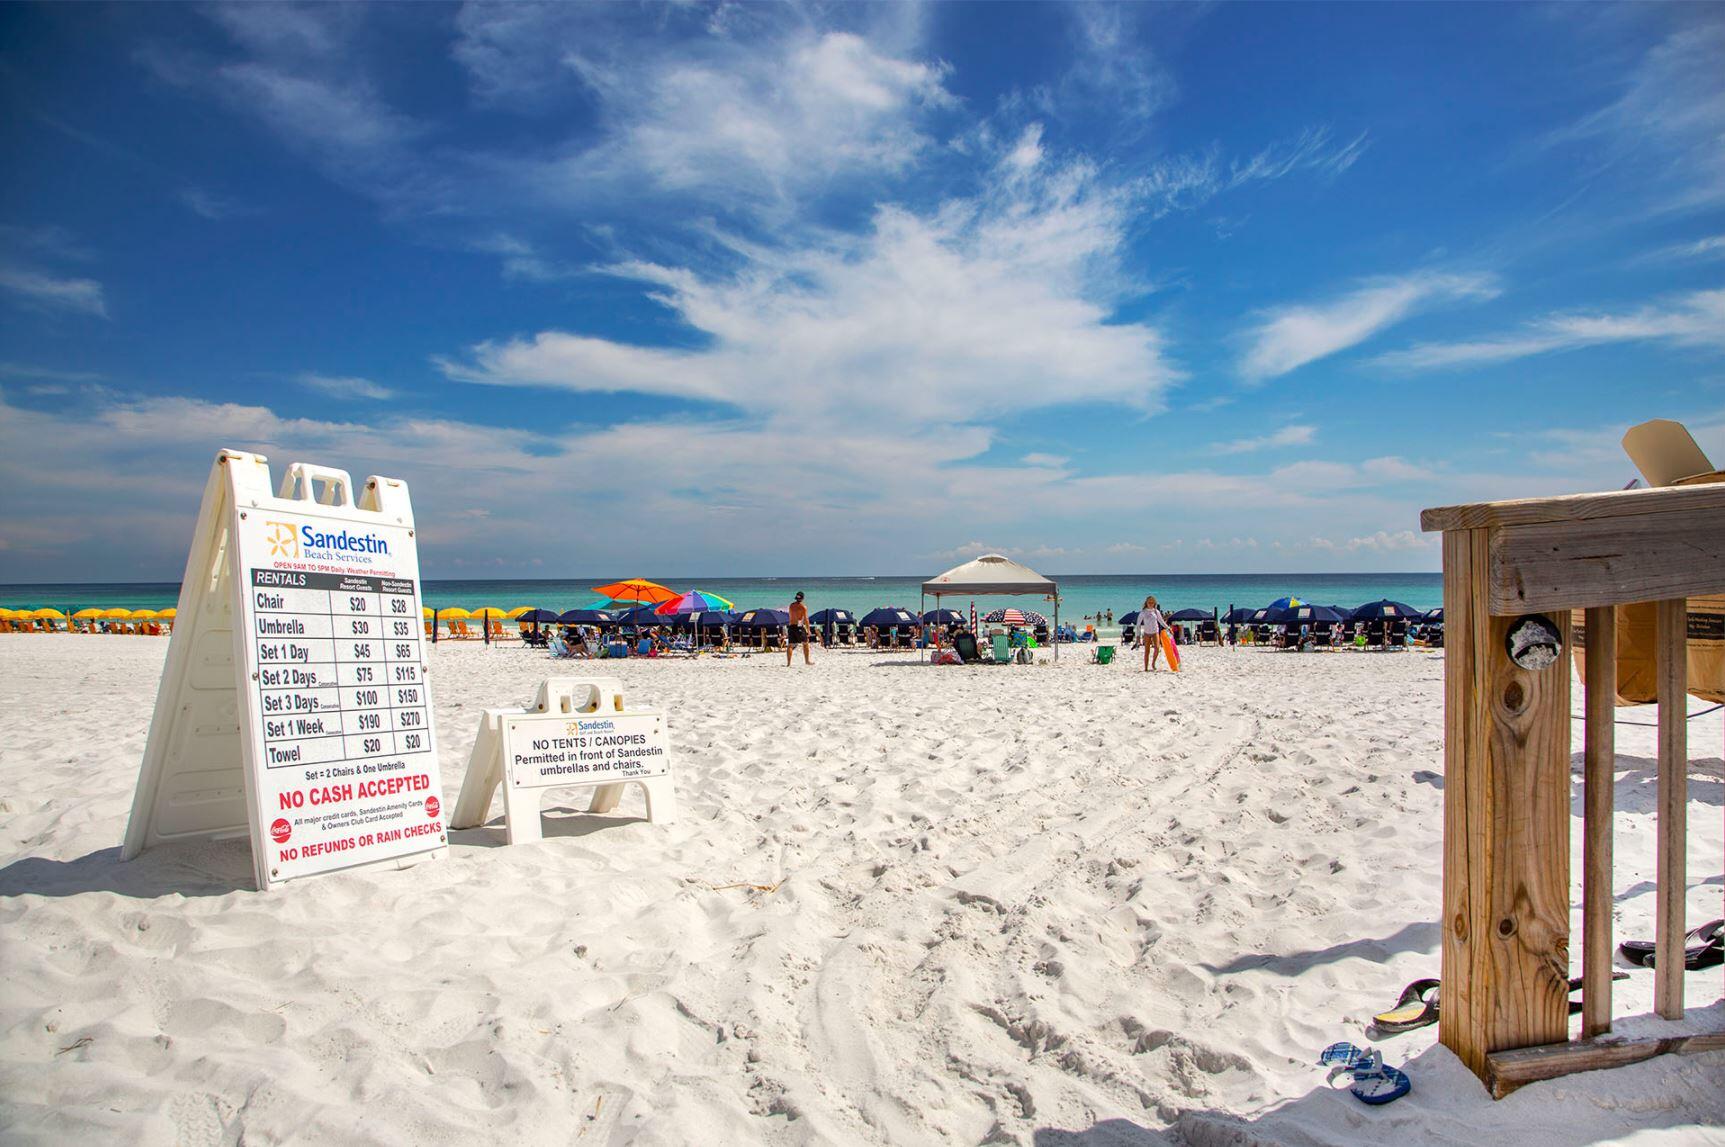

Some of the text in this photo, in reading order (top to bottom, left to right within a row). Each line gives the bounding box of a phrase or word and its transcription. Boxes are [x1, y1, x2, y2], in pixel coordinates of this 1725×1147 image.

[301, 525, 389, 555] Sandestin
[304, 549, 372, 564] Beach Services
[274, 561, 292, 570] OPEN
[293, 563, 306, 571] 9AM
[308, 564, 316, 572] TO
[317, 565, 330, 573] 5PM
[347, 567, 369, 575] Weather
[369, 569, 396, 578] Permitting
[256, 571, 306, 586] RENTALS
[344, 577, 368, 585] Sandestin
[340, 583, 356, 591] Resort
[257, 593, 285, 609] Chair
[350, 597, 366, 612] $20
[391, 599, 407, 613] $28
[259, 618, 305, 635] Umbrella
[352, 621, 369, 634] $30
[393, 621, 409, 635] $35
[261, 644, 309, 663] Set 1 Day
[354, 643, 371, 658] $45
[396, 644, 411, 658] $65
[262, 670, 281, 685] Set
[283, 669, 290, 685] 2
[292, 669, 317, 687] Days
[356, 667, 373, 682] $75
[396, 667, 416, 681] $115
[265, 696, 282, 711] Set
[285, 695, 292, 710] 3
[294, 694, 319, 713] Days
[356, 690, 378, 706] $100
[398, 689, 418, 703] $150
[267, 721, 285, 737] Set
[288, 721, 294, 736] 1
[297, 718, 325, 735] Week
[359, 714, 381, 730] $190
[400, 712, 421, 727] $270
[578, 720, 614, 731] Sandestin
[363, 738, 381, 753] $20
[406, 735, 421, 749] $20
[532, 734, 646, 750] NO TENTS / CANOPIES
[269, 745, 301, 764] Towel
[515, 746, 663, 765] Permitted in front of Sandestin
[305, 770, 318, 781] Set
[326, 769, 331, 778] 2
[333, 767, 355, 777] Chairs
[356, 766, 362, 774] &
[363, 764, 376, 773] One
[377, 761, 406, 772] Umbrella
[540, 759, 644, 776] umbrellas and chairs.
[279, 774, 430, 810] NO CASH ACCEPTED
[294, 818, 303, 826] All
[304, 815, 321, 825] major
[323, 813, 340, 822] credit
[341, 811, 359, 821] cards,
[359, 806, 386, 816] Sandestin
[387, 803, 408, 812] Amenity
[408, 800, 423, 809] Cards
[327, 821, 349, 830] Owners
[351, 818, 365, 826] Club
[365, 816, 378, 824] Card
[379, 812, 404, 821] Accepted
[280, 822, 442, 862] NO REFUNDS OR RAIN CHECKS
